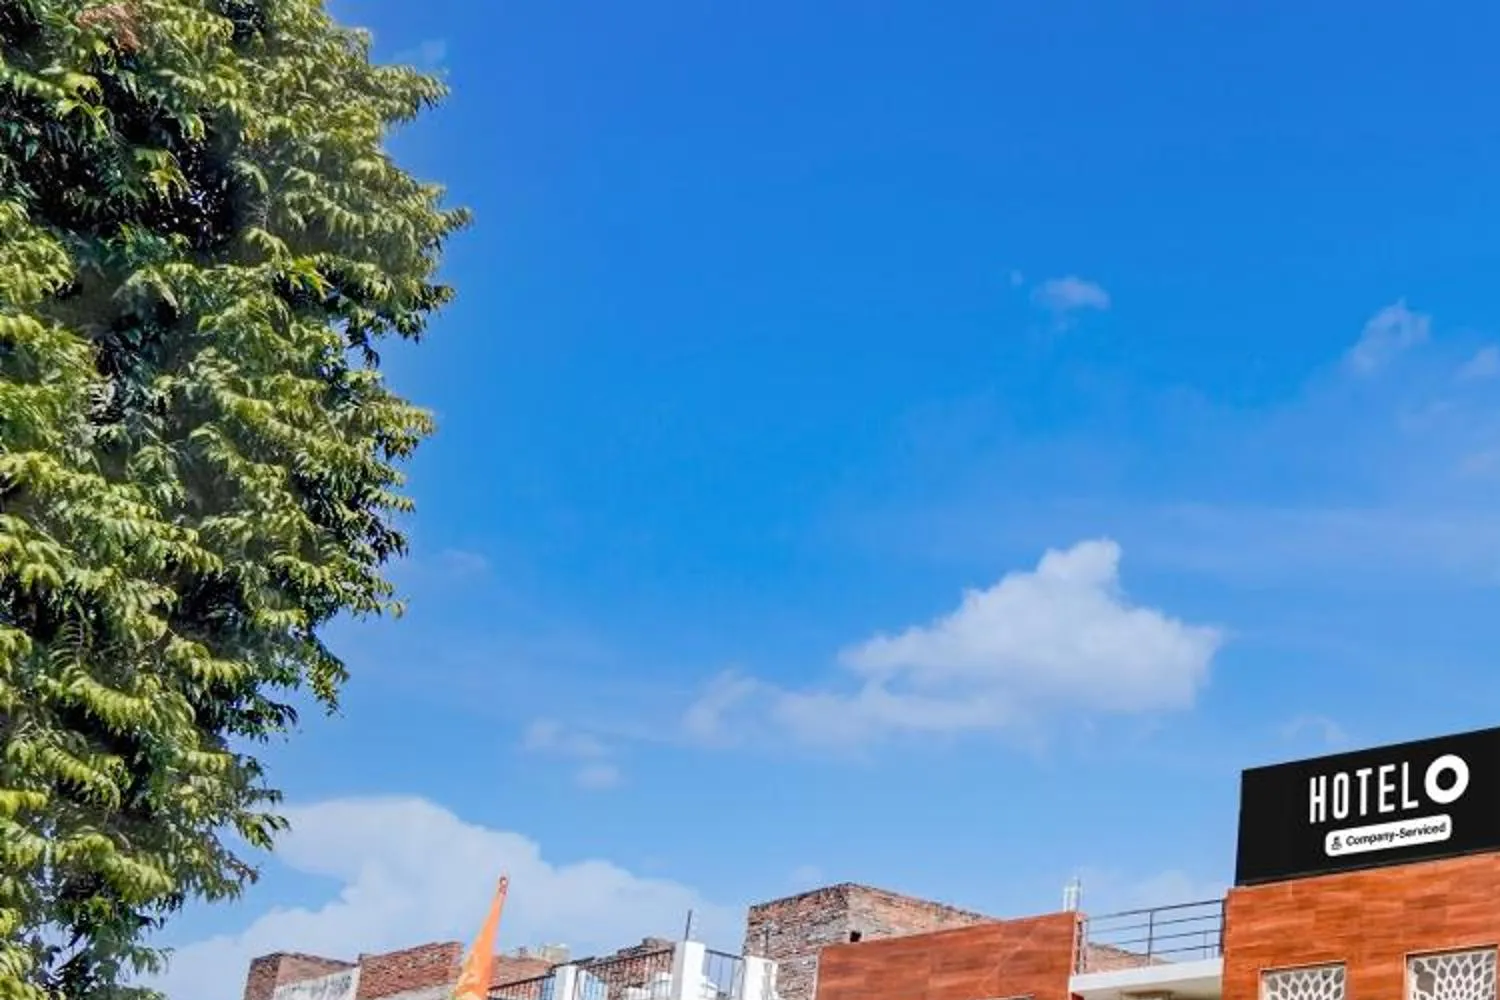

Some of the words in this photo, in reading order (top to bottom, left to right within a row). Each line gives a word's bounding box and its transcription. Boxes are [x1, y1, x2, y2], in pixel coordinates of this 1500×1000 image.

[1309, 761, 1419, 825] HOTEL
[1424, 753, 1470, 804] O
[1345, 822, 1447, 848] Company-Serviced
